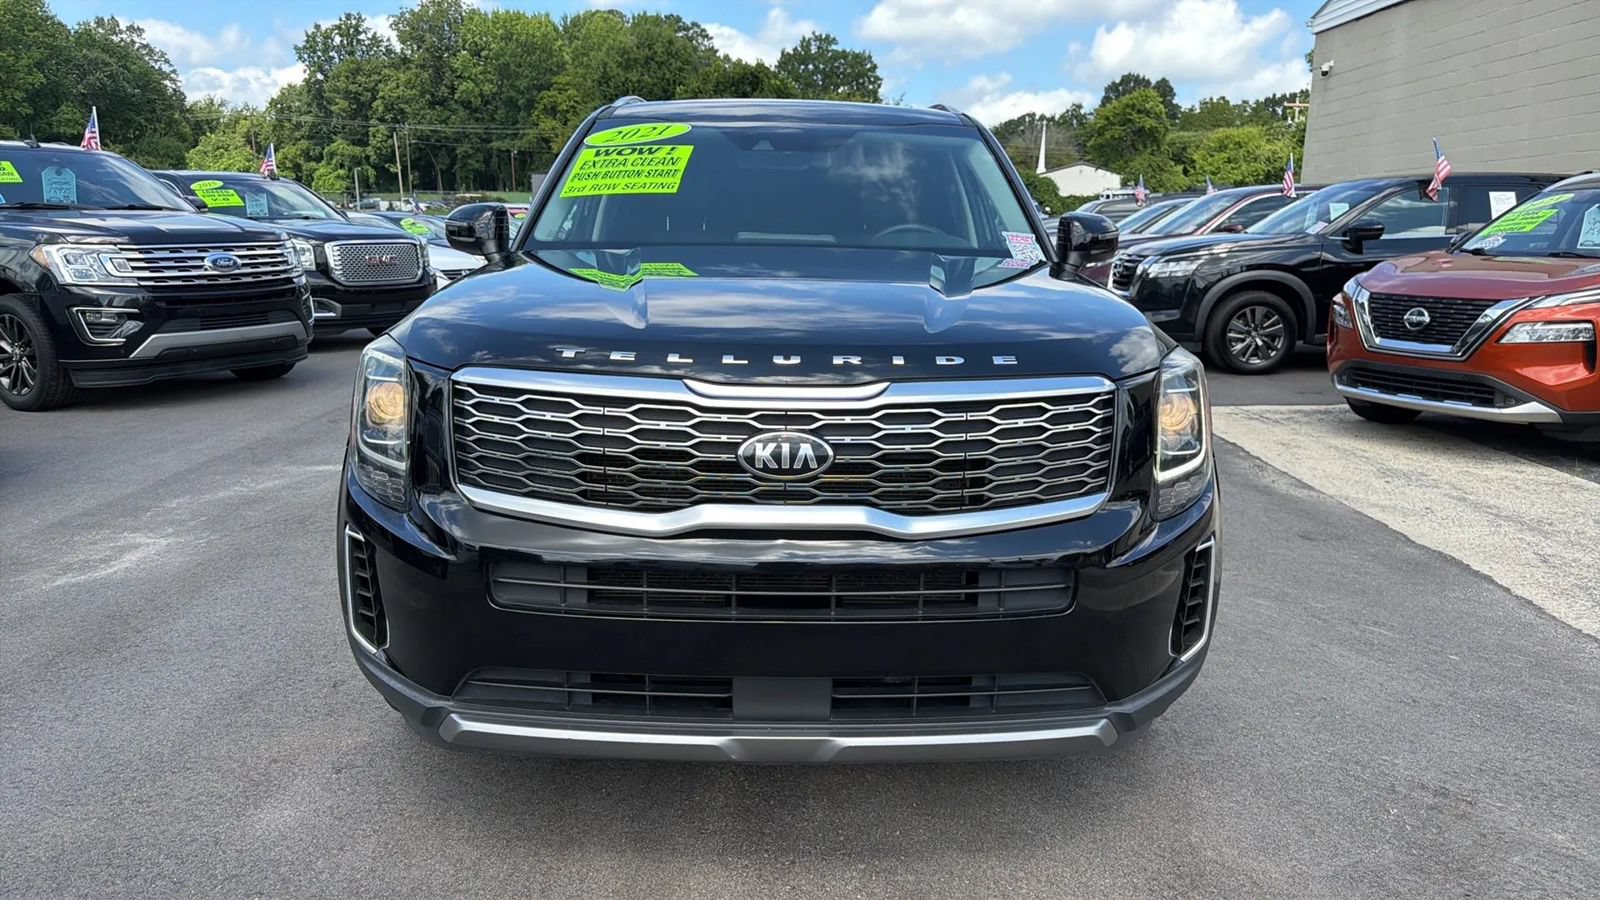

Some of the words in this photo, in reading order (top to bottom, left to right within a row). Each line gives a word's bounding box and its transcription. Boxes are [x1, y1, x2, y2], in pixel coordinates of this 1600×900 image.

[601, 125, 669, 143] 2021
[593, 147, 661, 158] WOW
[579, 158, 627, 170] EXTRA
[630, 157, 679, 167] CLEAN
[570, 171, 599, 182] PUSH
[600, 169, 642, 180] BUTTON
[644, 168, 680, 178] START
[564, 185, 586, 194] 3rd
[588, 183, 621, 192] ROW
[622, 181, 677, 190] SEATING
[365, 255, 400, 266] GMC
[555, 348, 1019, 365] TELLURIDE
[754, 442, 819, 469] KIA
